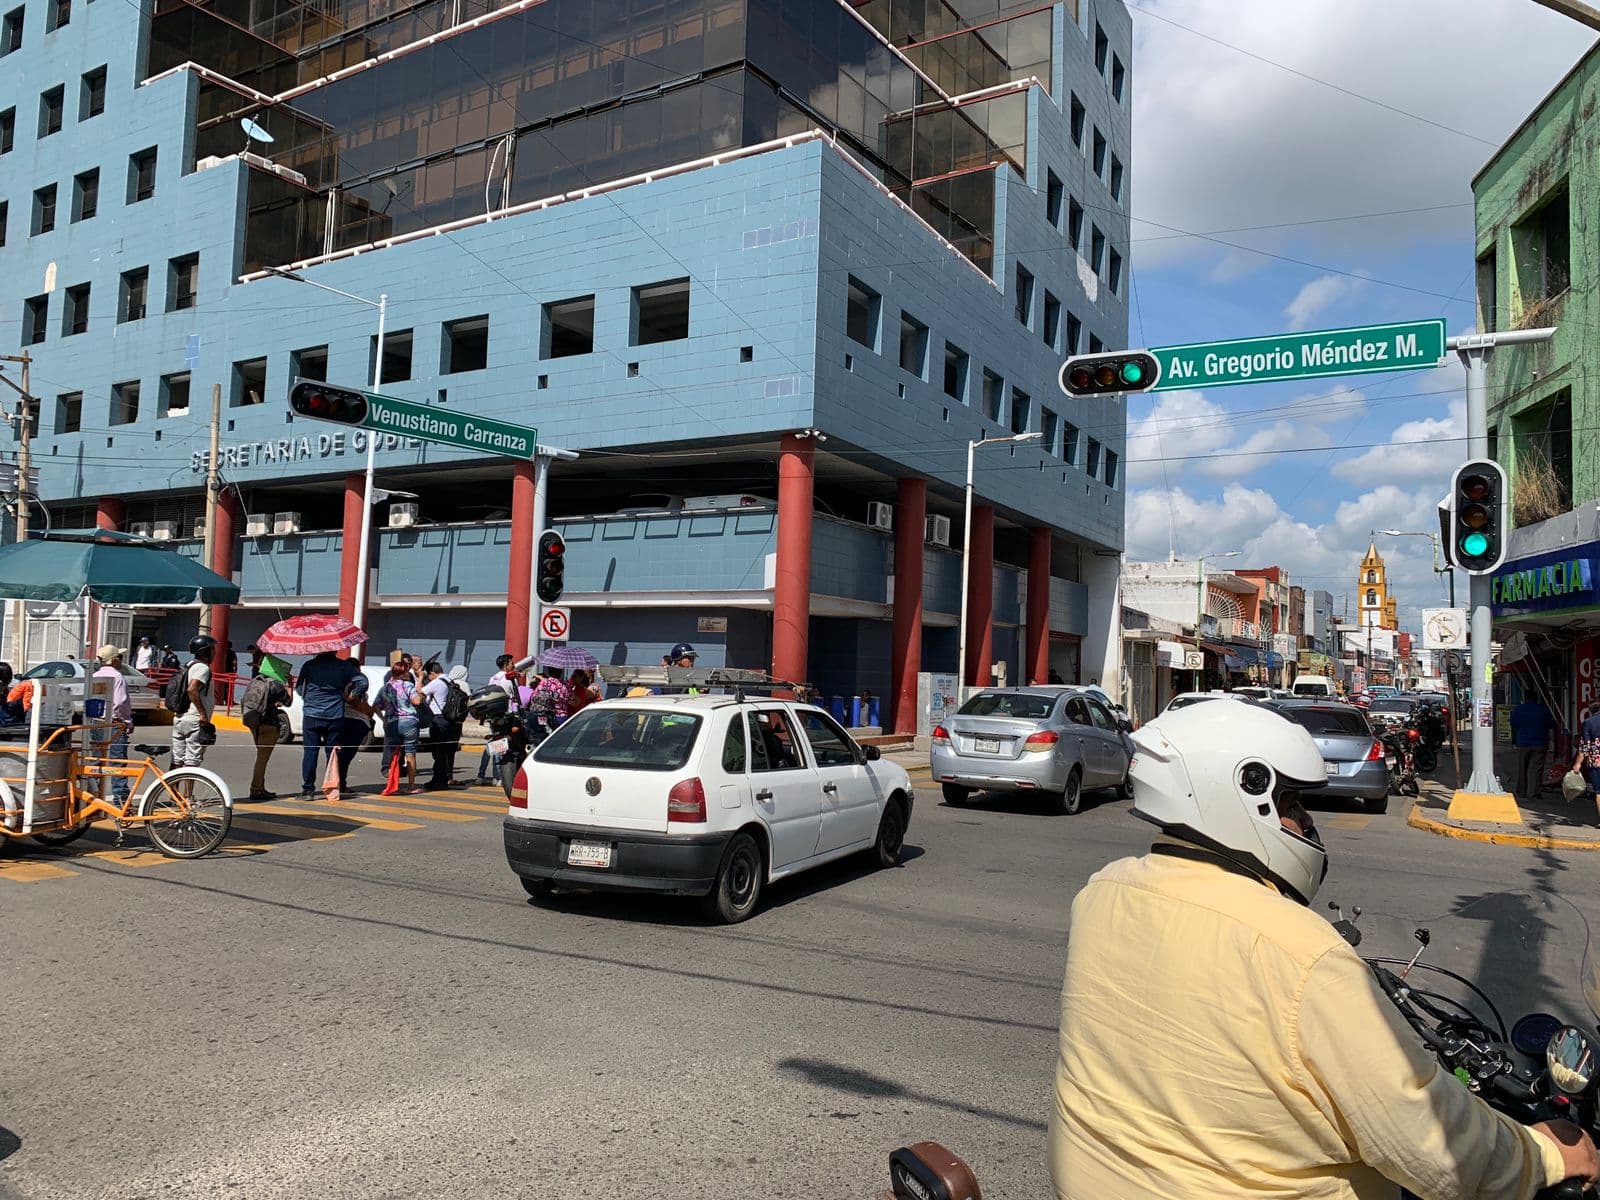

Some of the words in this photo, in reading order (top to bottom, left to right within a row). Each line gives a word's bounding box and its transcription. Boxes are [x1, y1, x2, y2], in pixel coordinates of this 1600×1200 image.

[1168, 357, 1198, 379] Av.
[1204, 347, 1295, 377] Gregorio
[1302, 340, 1389, 368] Méndez
[1395, 333, 1424, 358] M.
[318, 431, 345, 457] DE
[371, 403, 458, 437] Venustiano
[464, 422, 527, 451] Carranza
[1492, 559, 1584, 605] FARMACIA
